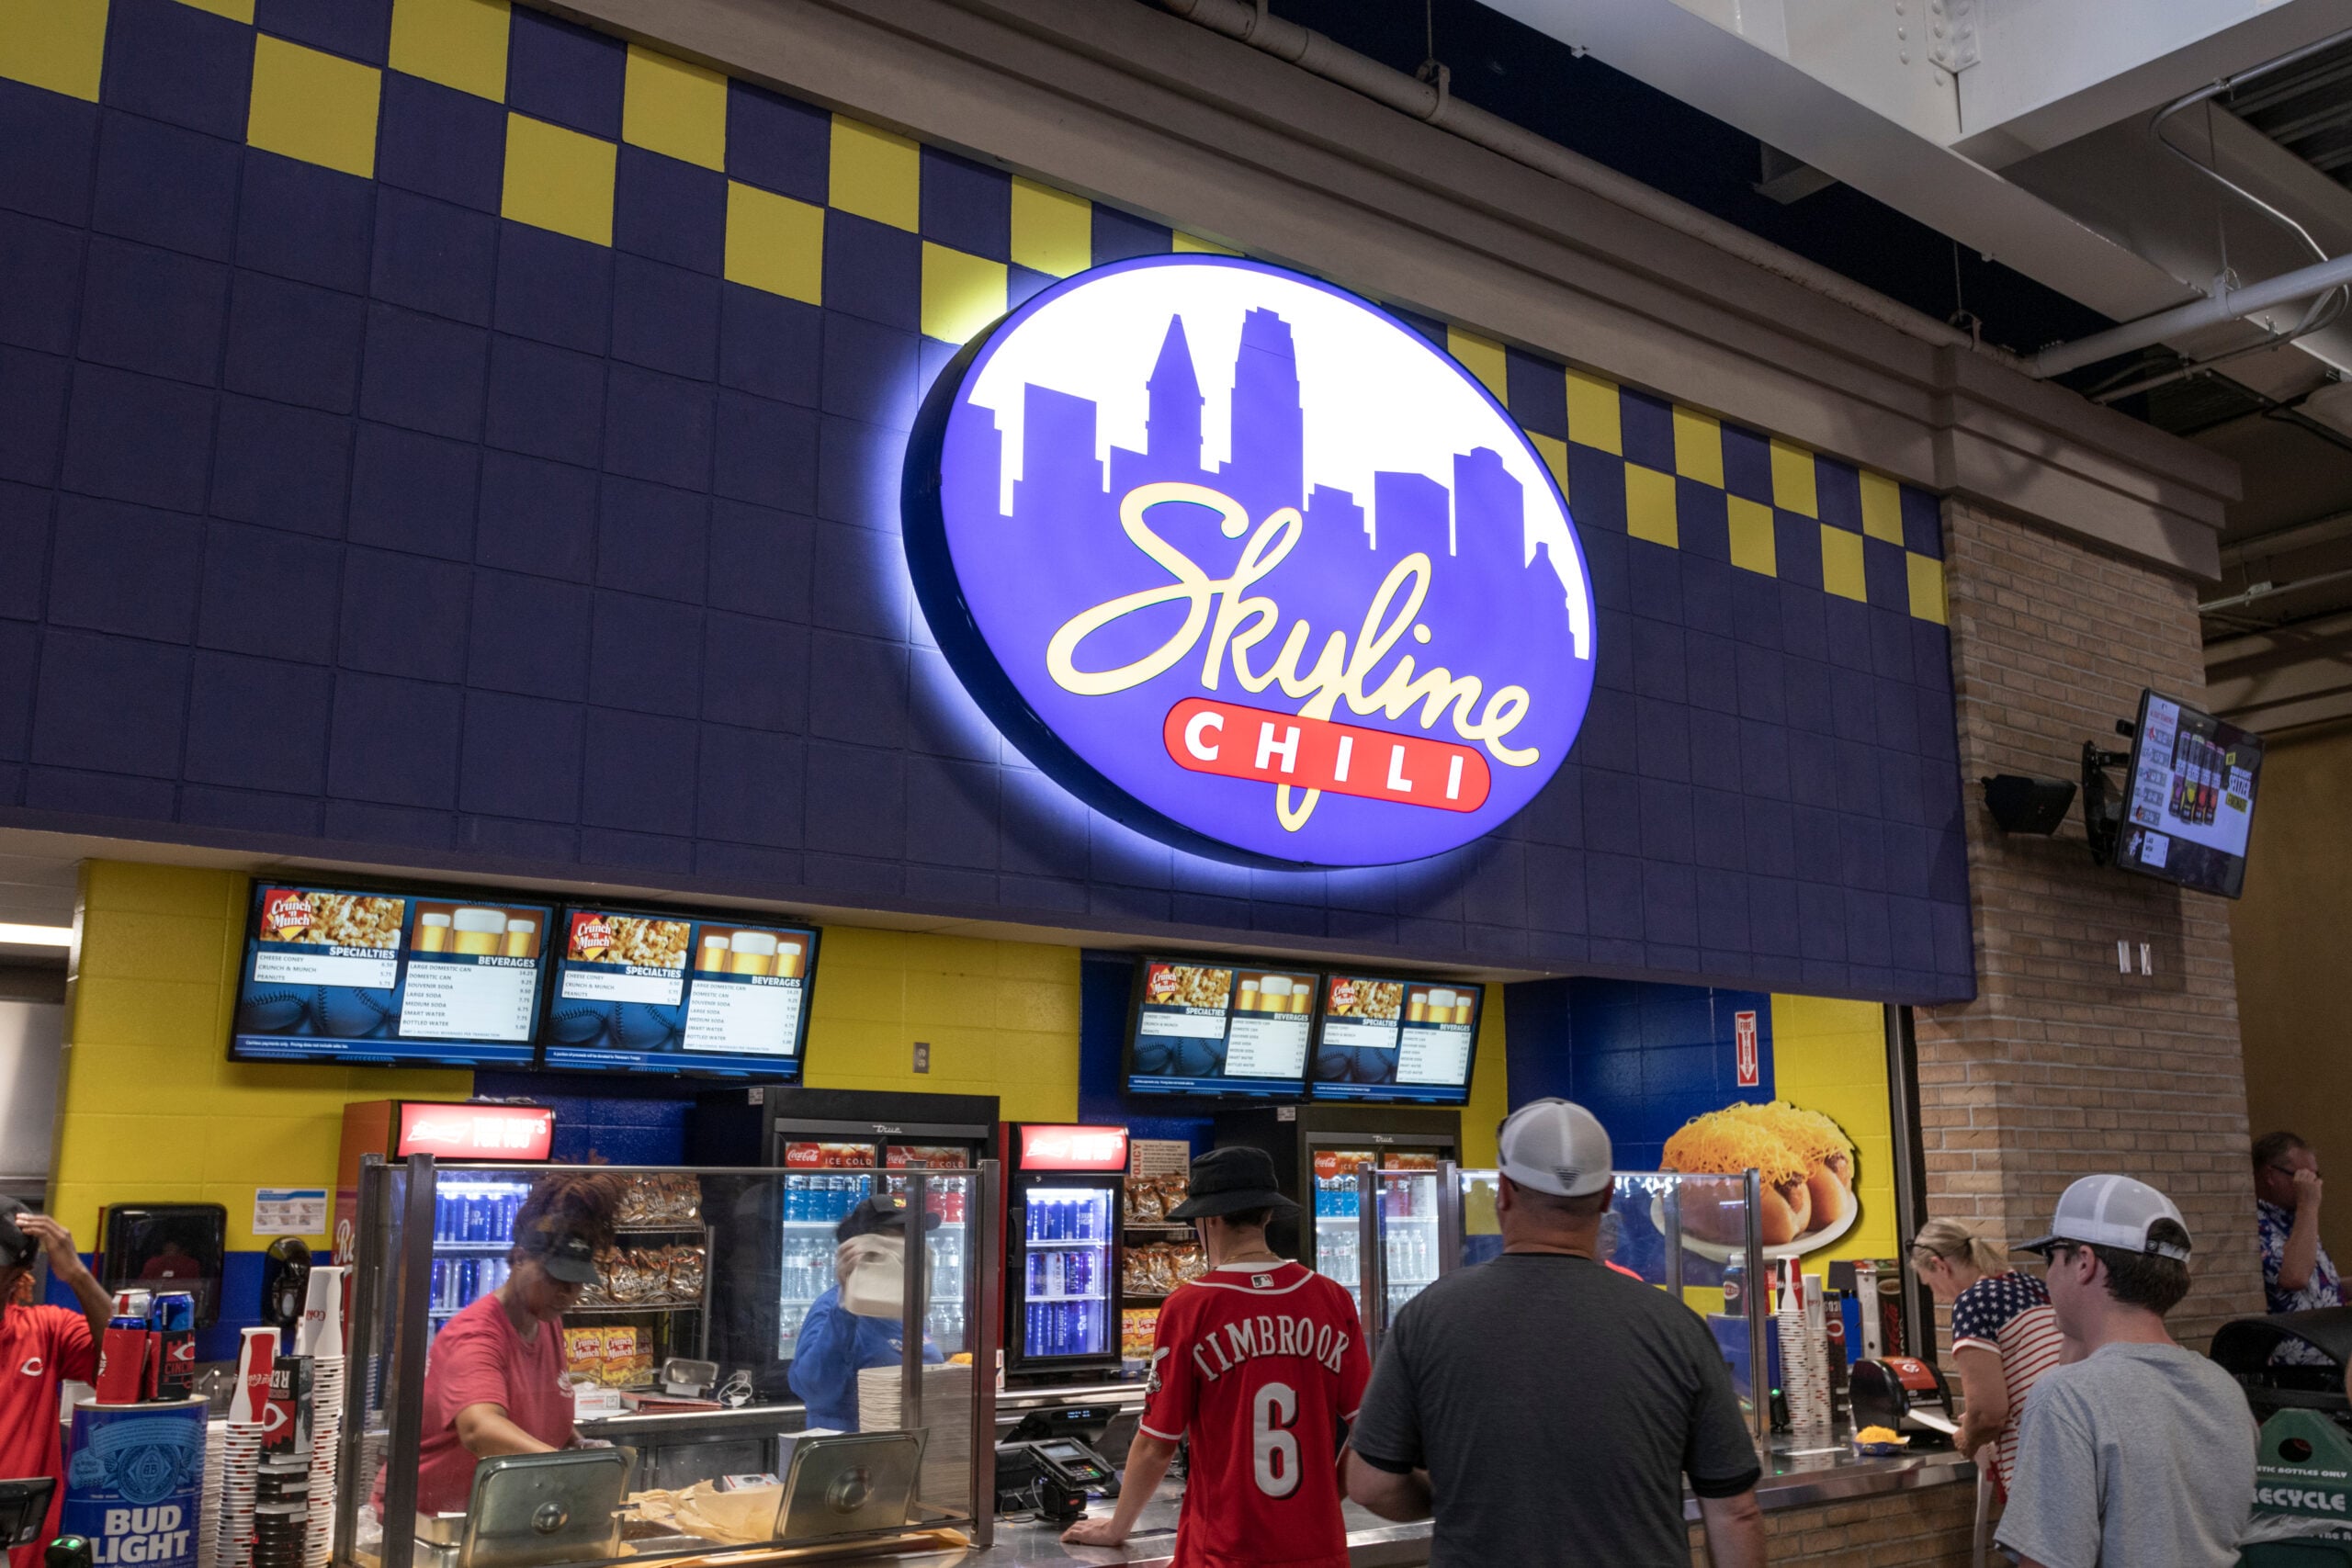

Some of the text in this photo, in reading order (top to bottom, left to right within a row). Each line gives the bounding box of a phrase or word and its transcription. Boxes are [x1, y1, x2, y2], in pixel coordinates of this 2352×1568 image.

[1046, 481, 1540, 832] Skyline
[1183, 711, 1464, 800] CHILI
[272, 899, 311, 915] Crunch
[273, 913, 311, 930] Munch
[577, 921, 612, 937] Crunch
[577, 935, 611, 950] Munch
[329, 945, 395, 959] SPECIALTIES
[478, 955, 536, 968] BEVERAGES
[625, 965, 682, 978] SPECIALTIES
[1153, 972, 1177, 984] Crunch
[752, 976, 801, 987] BEVERAGES
[1154, 983, 1176, 995] Munch
[1185, 1007, 1226, 1017] SPECIALTIES
[1273, 1013, 1309, 1021] BEVERAGES
[1363, 1018, 1397, 1027] SPECIALTIES
[1440, 1023, 1471, 1032] BEVERAGES
[872, 1124, 902, 1134] True
[825, 1157, 842, 1166] ICE
[845, 1157, 873, 1167] COLD
[1132, 1143, 1141, 1178] OLICY
[1340, 1163, 1352, 1171] ICE
[572, 1337, 600, 1351] Crunch
[605, 1337, 634, 1350] Crunch
[1193, 1314, 1350, 1382] TIMBROOK
[574, 1349, 600, 1360] Munch
[607, 1348, 633, 1360] Munch
[1252, 1382, 1304, 1500] 6
[2278, 1467, 2319, 1476] BOTTLES
[2321, 1470, 2347, 1478] ONLY
[104, 1505, 182, 1536] BUD
[90, 1529, 190, 1564] LIGHT
